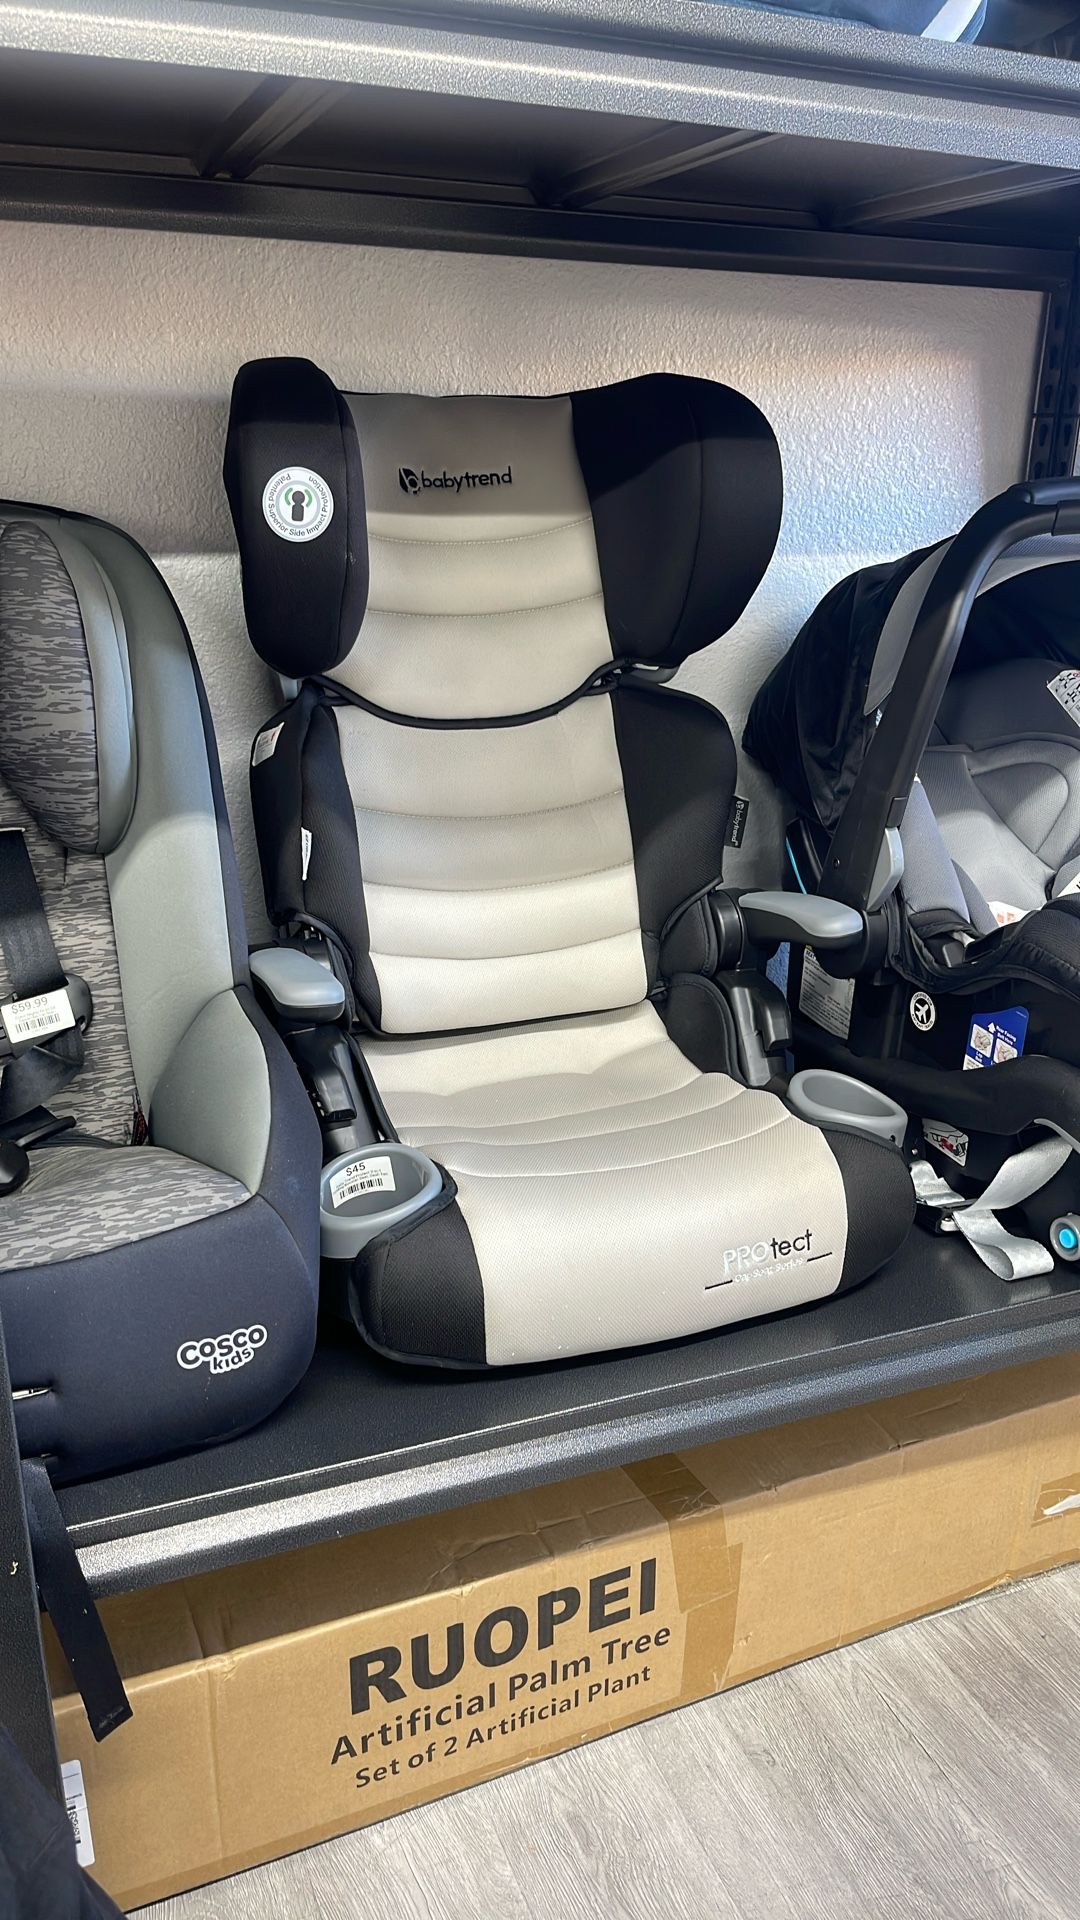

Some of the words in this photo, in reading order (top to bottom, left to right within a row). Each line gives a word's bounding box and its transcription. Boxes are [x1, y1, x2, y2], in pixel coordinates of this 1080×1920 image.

[268, 473, 292, 502] Patented
[421, 465, 512, 493] babytrend
[308, 475, 329, 513] Protection
[268, 503, 289, 533] Superior
[289, 528, 306, 537] Side
[306, 514, 327, 535] Impact
[11, 996, 48, 1014] $59.99
[345, 1161, 366, 1177] $45
[722, 1229, 812, 1274] PROtect
[212, 1347, 252, 1371] kids
[349, 1557, 657, 1715] RUOPEI
[331, 1682, 496, 1765] Artificial
[508, 1655, 591, 1701] Palm
[601, 1627, 671, 1665] Tree
[355, 1759, 401, 1788] Set
[407, 1741, 436, 1769] of
[443, 1737, 458, 1757] 2
[466, 1690, 580, 1749] Artificial
[588, 1665, 651, 1702] Plant
